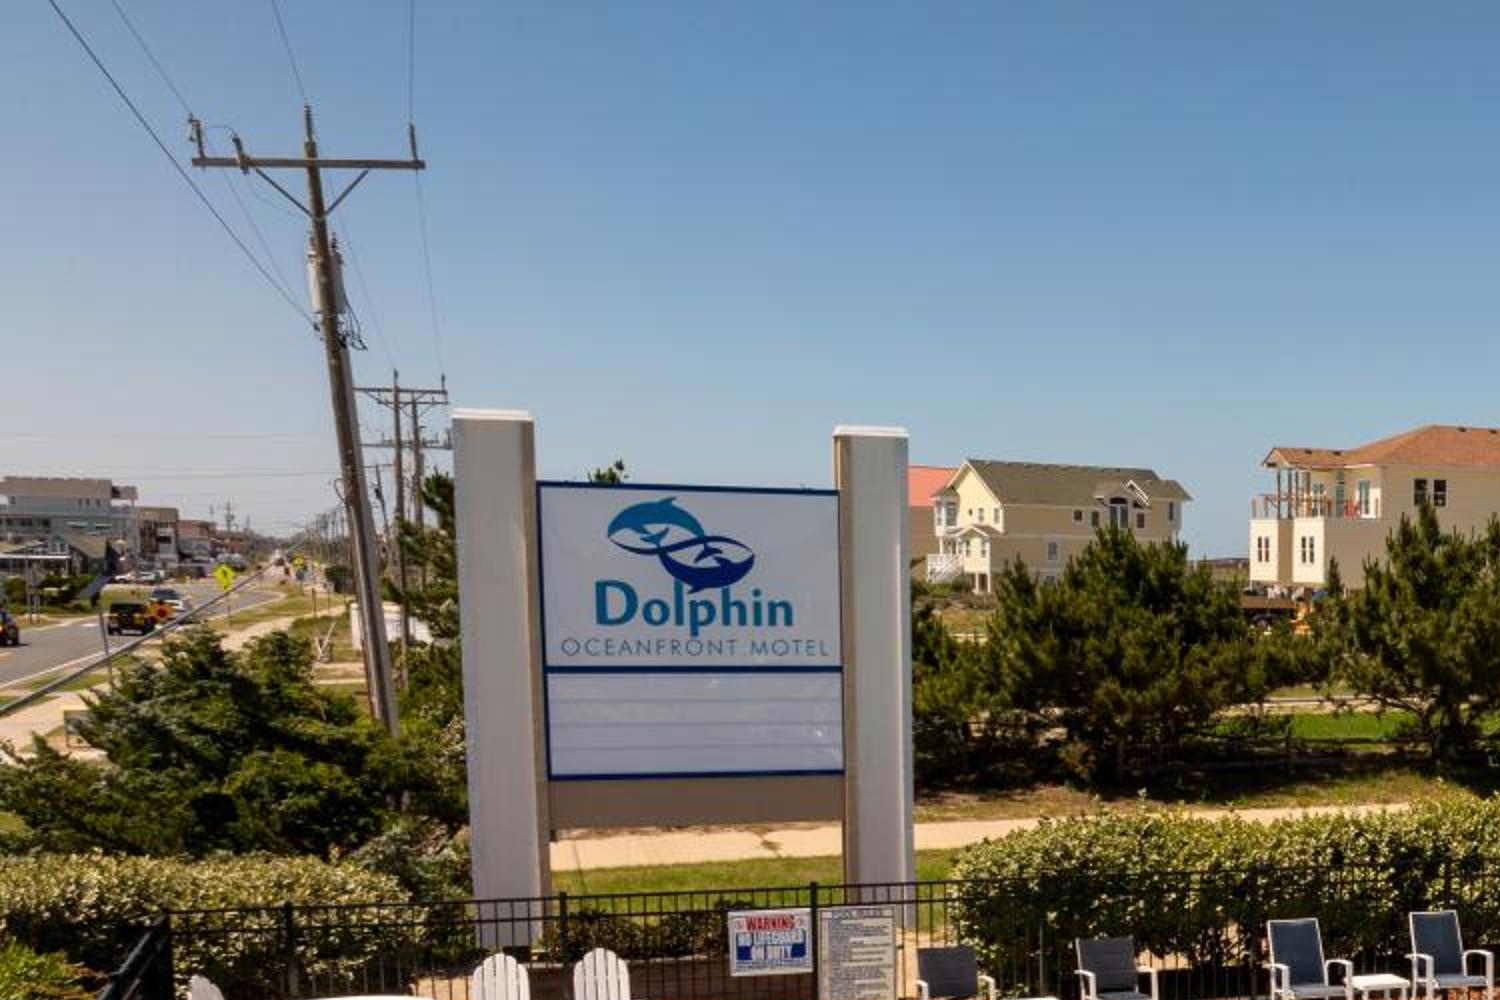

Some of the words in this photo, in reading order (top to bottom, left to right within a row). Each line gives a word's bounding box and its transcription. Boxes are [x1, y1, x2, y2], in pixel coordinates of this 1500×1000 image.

[595, 577, 794, 637] Dolphin
[561, 637, 738, 657] OCEANFRONT
[752, 638, 829, 657] MOTEL
[746, 913, 795, 933] WARNING
